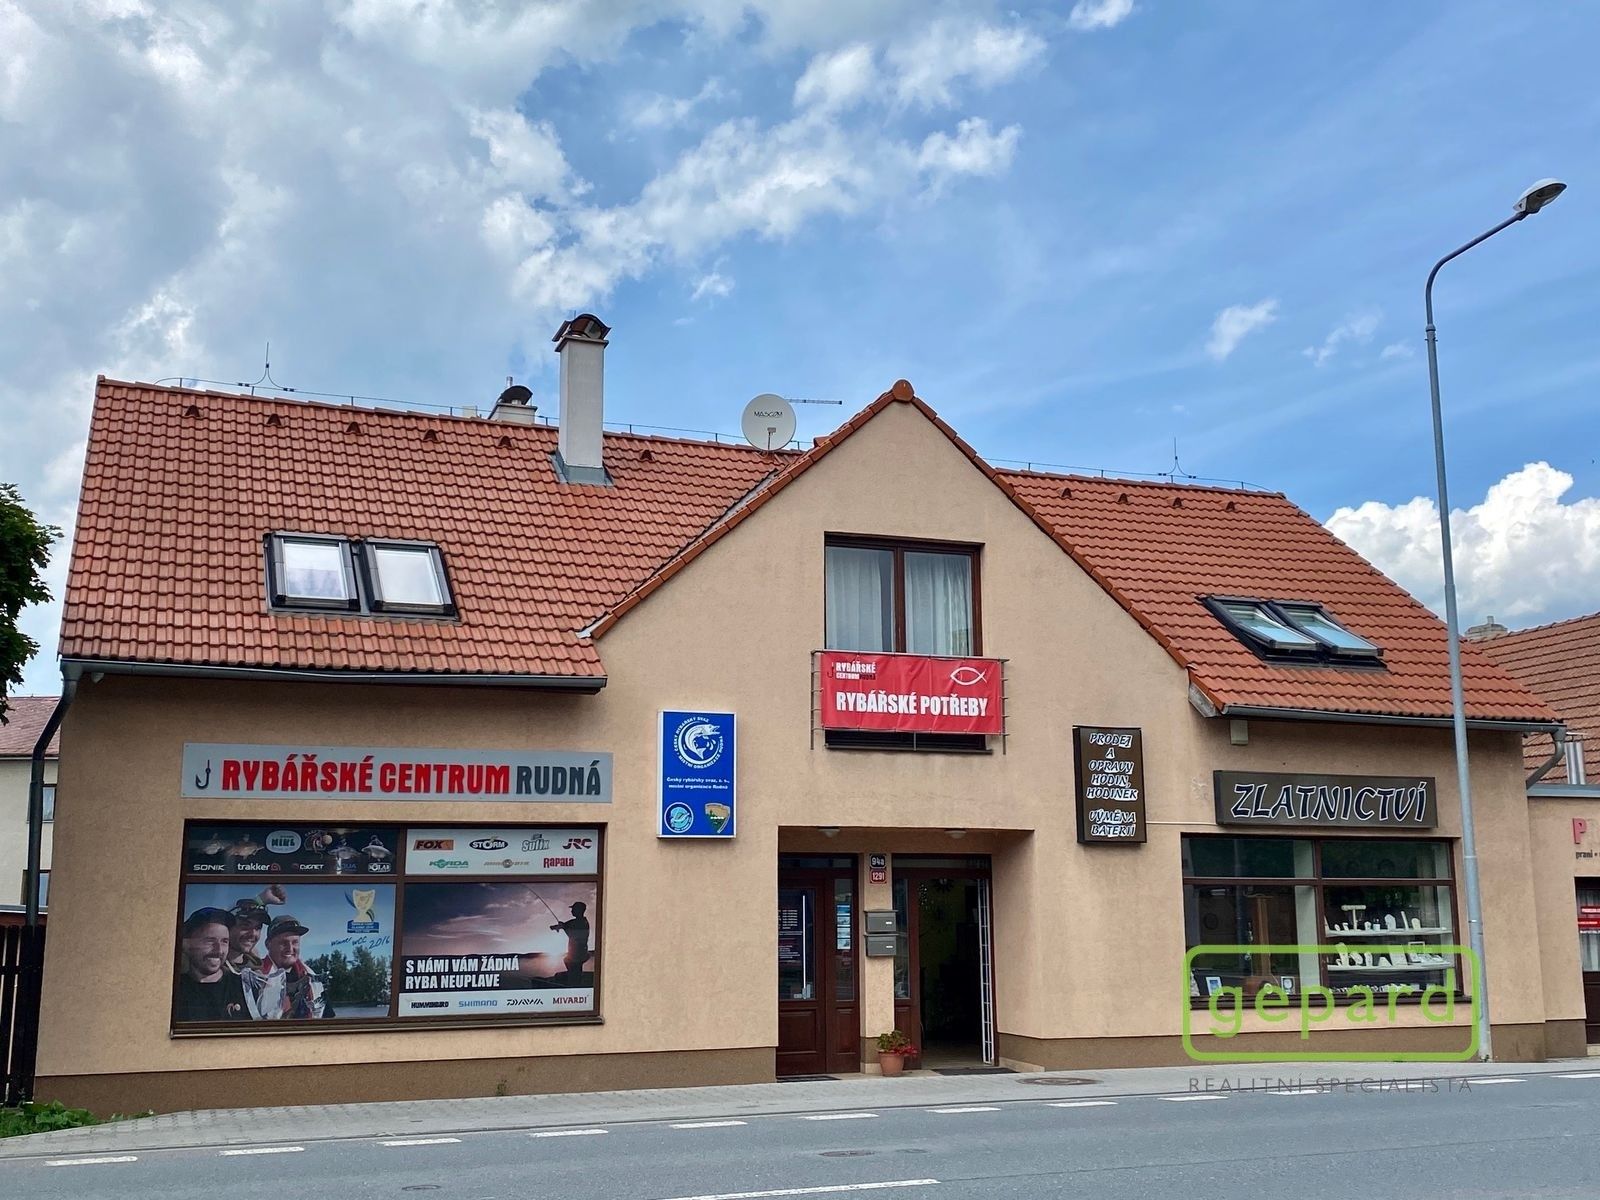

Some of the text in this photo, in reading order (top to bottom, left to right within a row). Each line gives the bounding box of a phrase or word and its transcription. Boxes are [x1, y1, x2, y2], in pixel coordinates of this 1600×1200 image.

[836, 661, 876, 674] RYBÁŘSKÉ
[836, 690, 988, 716] RYBÁŘSKÉ POTŘEBY
[1089, 733, 1132, 748] PRODEJ
[1105, 747, 1115, 759] A
[1088, 760, 1134, 774] OPRAVY
[222, 754, 600, 796] RYBÁŘSKÉ CENTRUM RUDNÁ
[1091, 774, 1131, 788] HODIN,
[1086, 787, 1138, 801] HODINEK
[1231, 781, 1427, 822] ZLATNICTVÍ
[1089, 808, 1136, 824] VÝMĚNA
[416, 840, 443, 850] FOX
[472, 838, 505, 849] STORM
[562, 838, 592, 850] JRC
[237, 863, 270, 871] trakker
[871, 857, 885, 866] 94a
[872, 872, 885, 881] 1291
[369, 936, 390, 950] 2016
[406, 955, 519, 973] S NÁMI VÁM ŽÁDNÁ
[405, 974, 500, 989] RYBA NEUPLAVE
[458, 999, 498, 1008] SHIMANO
[552, 996, 587, 1005] MIVARDI
